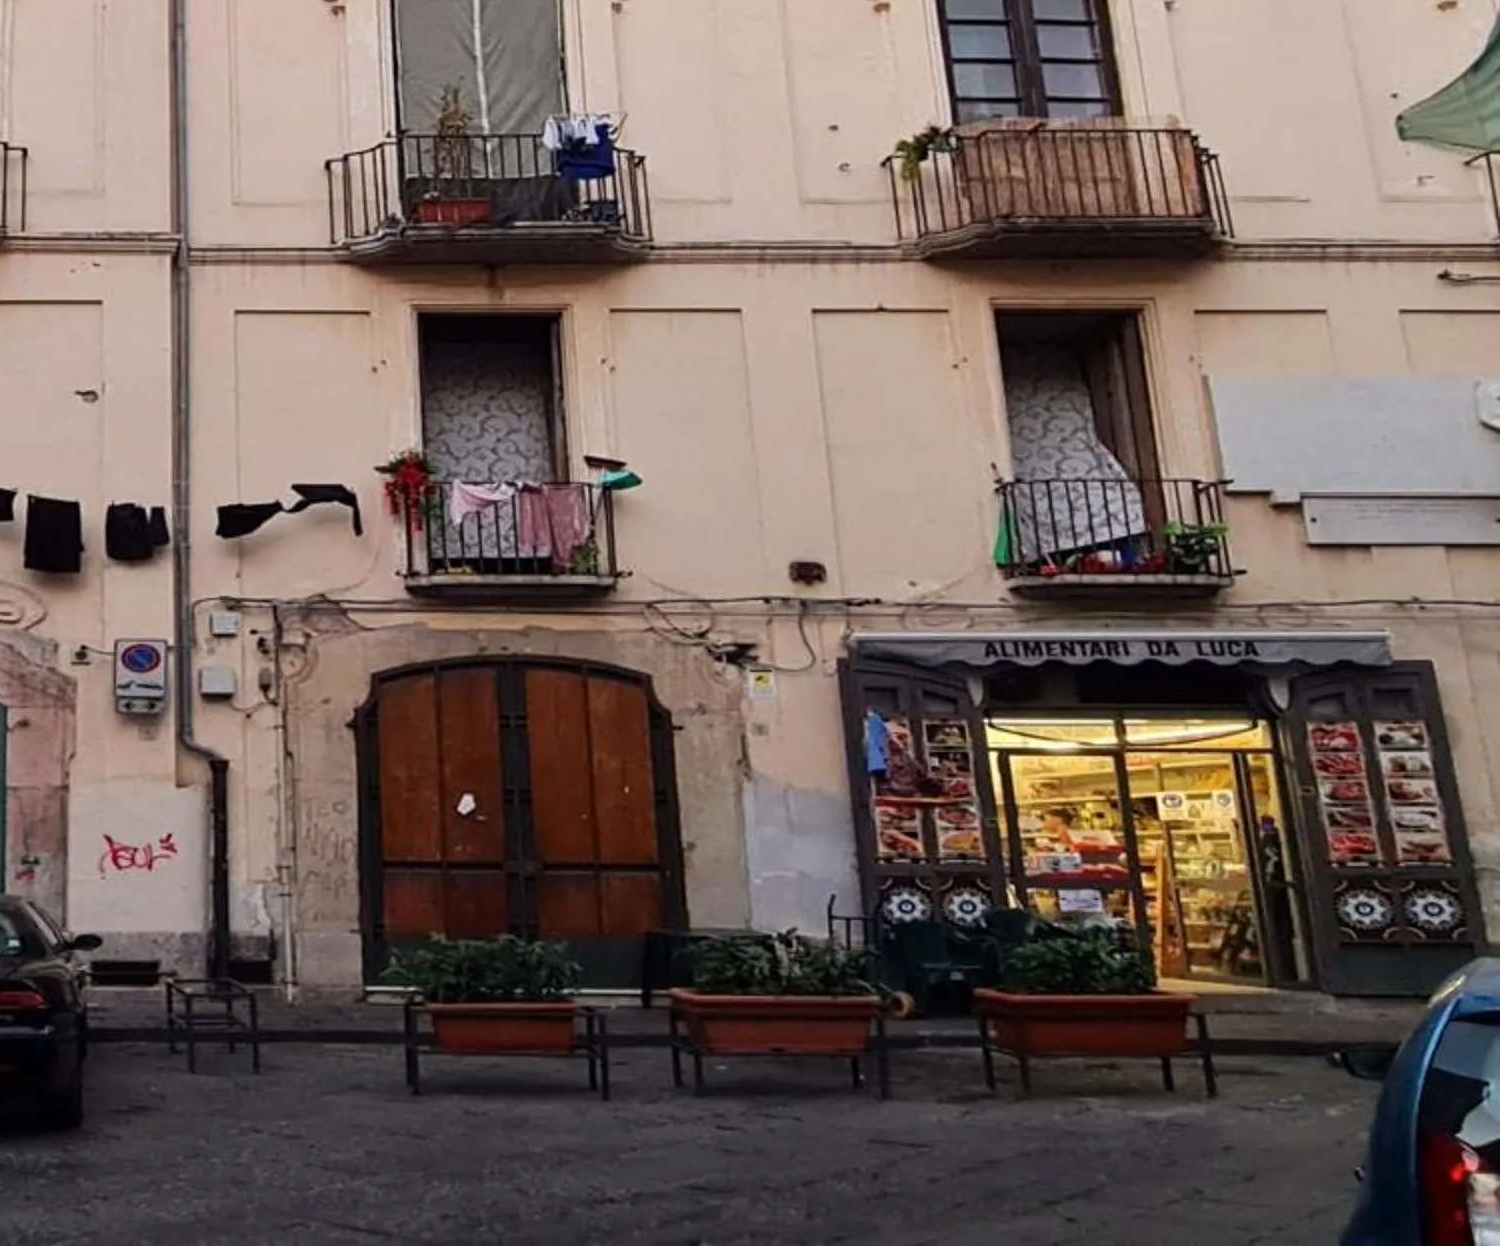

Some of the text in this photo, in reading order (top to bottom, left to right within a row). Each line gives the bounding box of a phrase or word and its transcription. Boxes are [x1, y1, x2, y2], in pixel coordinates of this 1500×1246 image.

[984, 640, 1260, 659] ALIMENTARI DA LUCA
